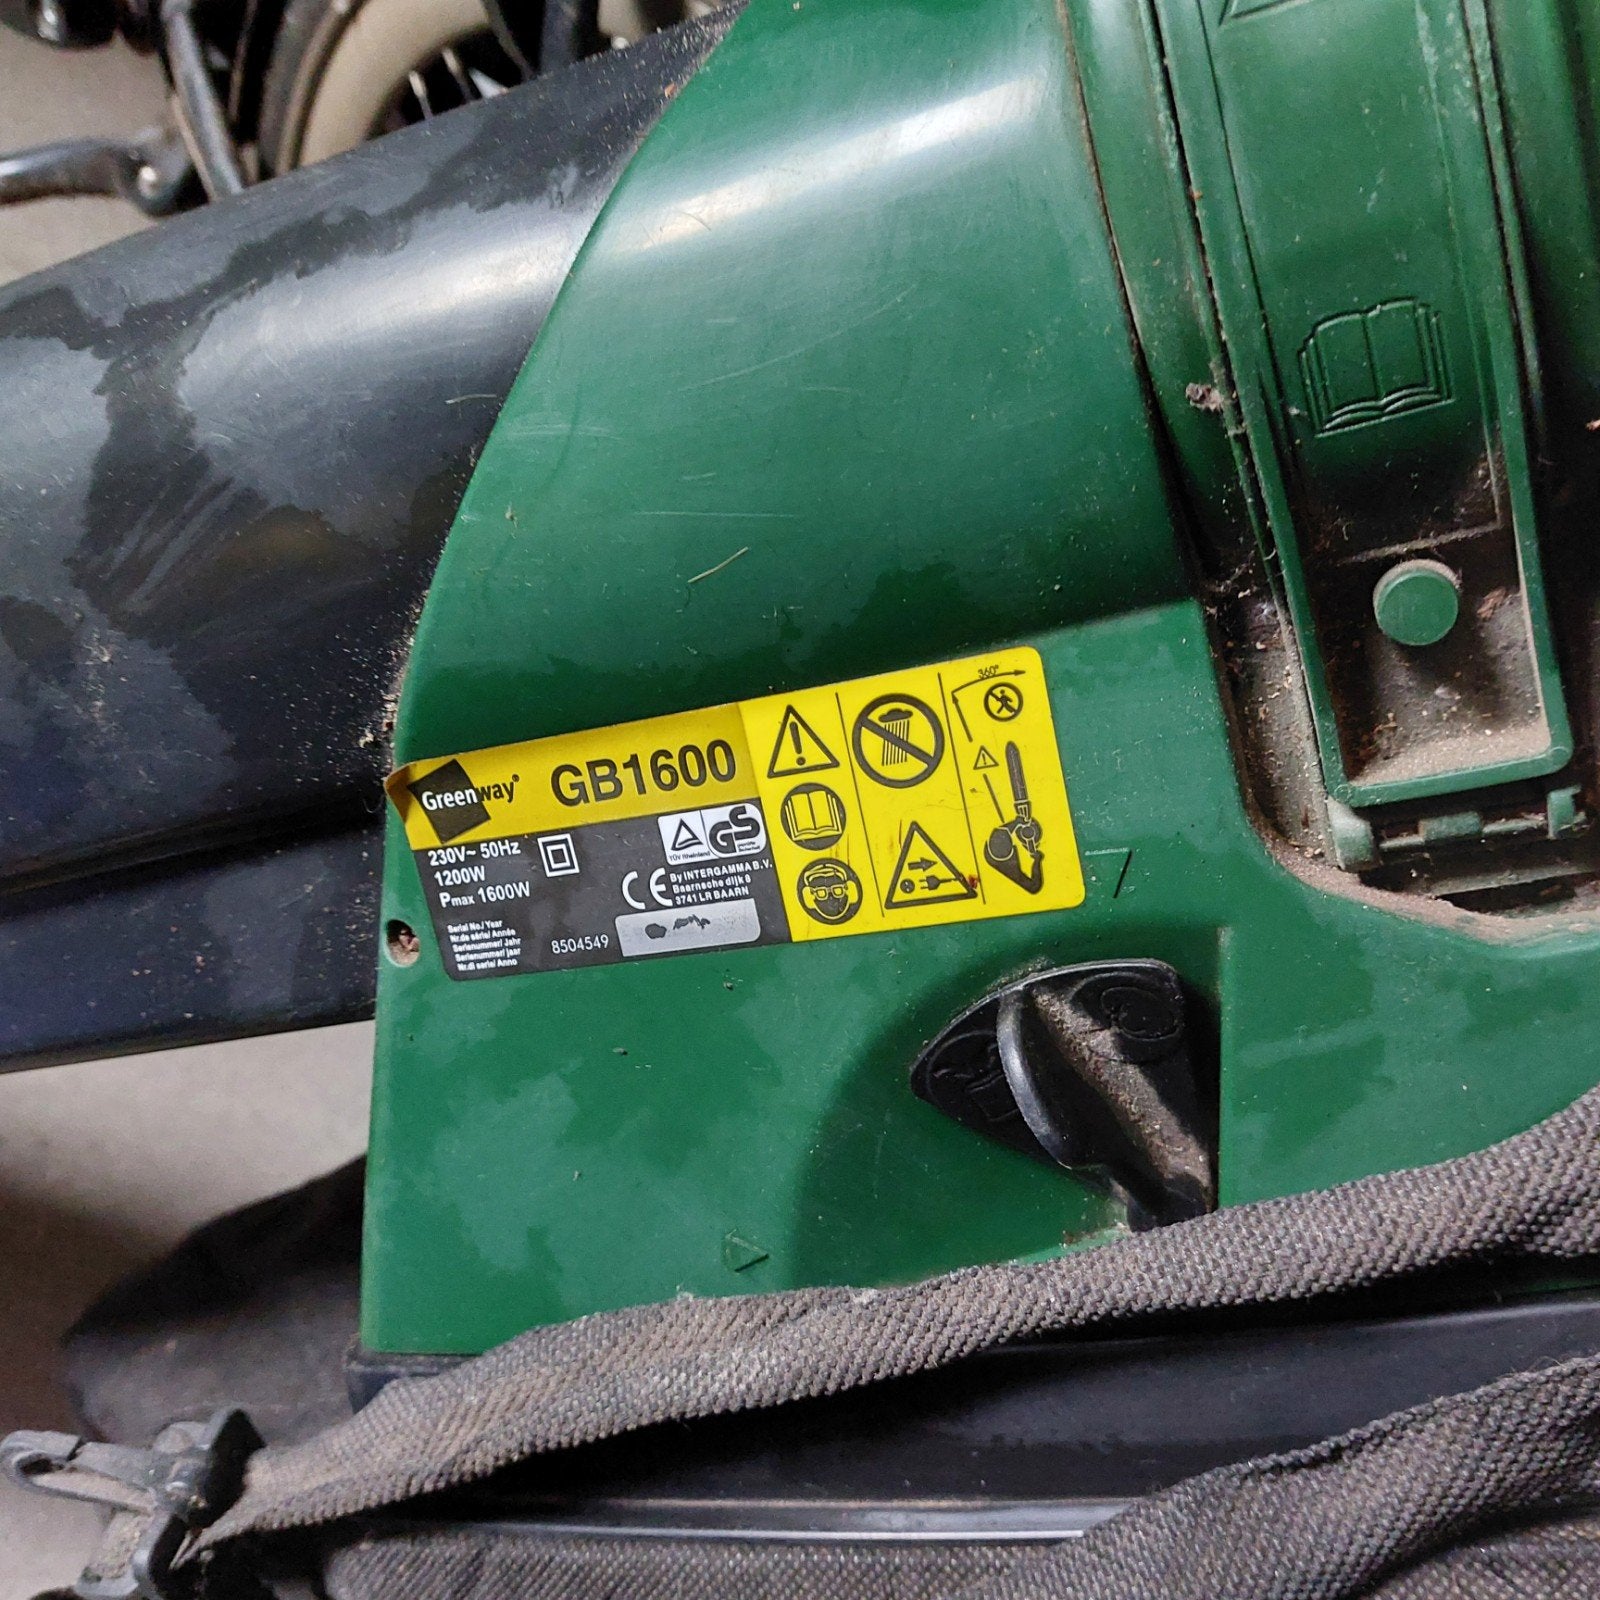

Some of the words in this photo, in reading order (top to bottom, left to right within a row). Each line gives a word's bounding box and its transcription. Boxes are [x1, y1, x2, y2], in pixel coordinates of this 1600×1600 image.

[550, 739, 737, 807] GB1600
[708, 805, 761, 854] GS
[480, 839, 521, 859] 50Hz
[434, 865, 486, 886] 1200W
[670, 873, 682, 883] By
[683, 862, 751, 880] INTERGAMMA
[752, 859, 773, 870] B.V.
[439, 892, 476, 908] Pmax
[477, 881, 530, 903] 1600W
[621, 867, 673, 909] CE
[675, 894, 698, 905] 3741
[699, 892, 713, 902] LR
[714, 886, 750, 900] BAARN
[485, 920, 503, 929] Year
[551, 934, 609, 954] 8504549
[497, 958, 518, 967] Anno
